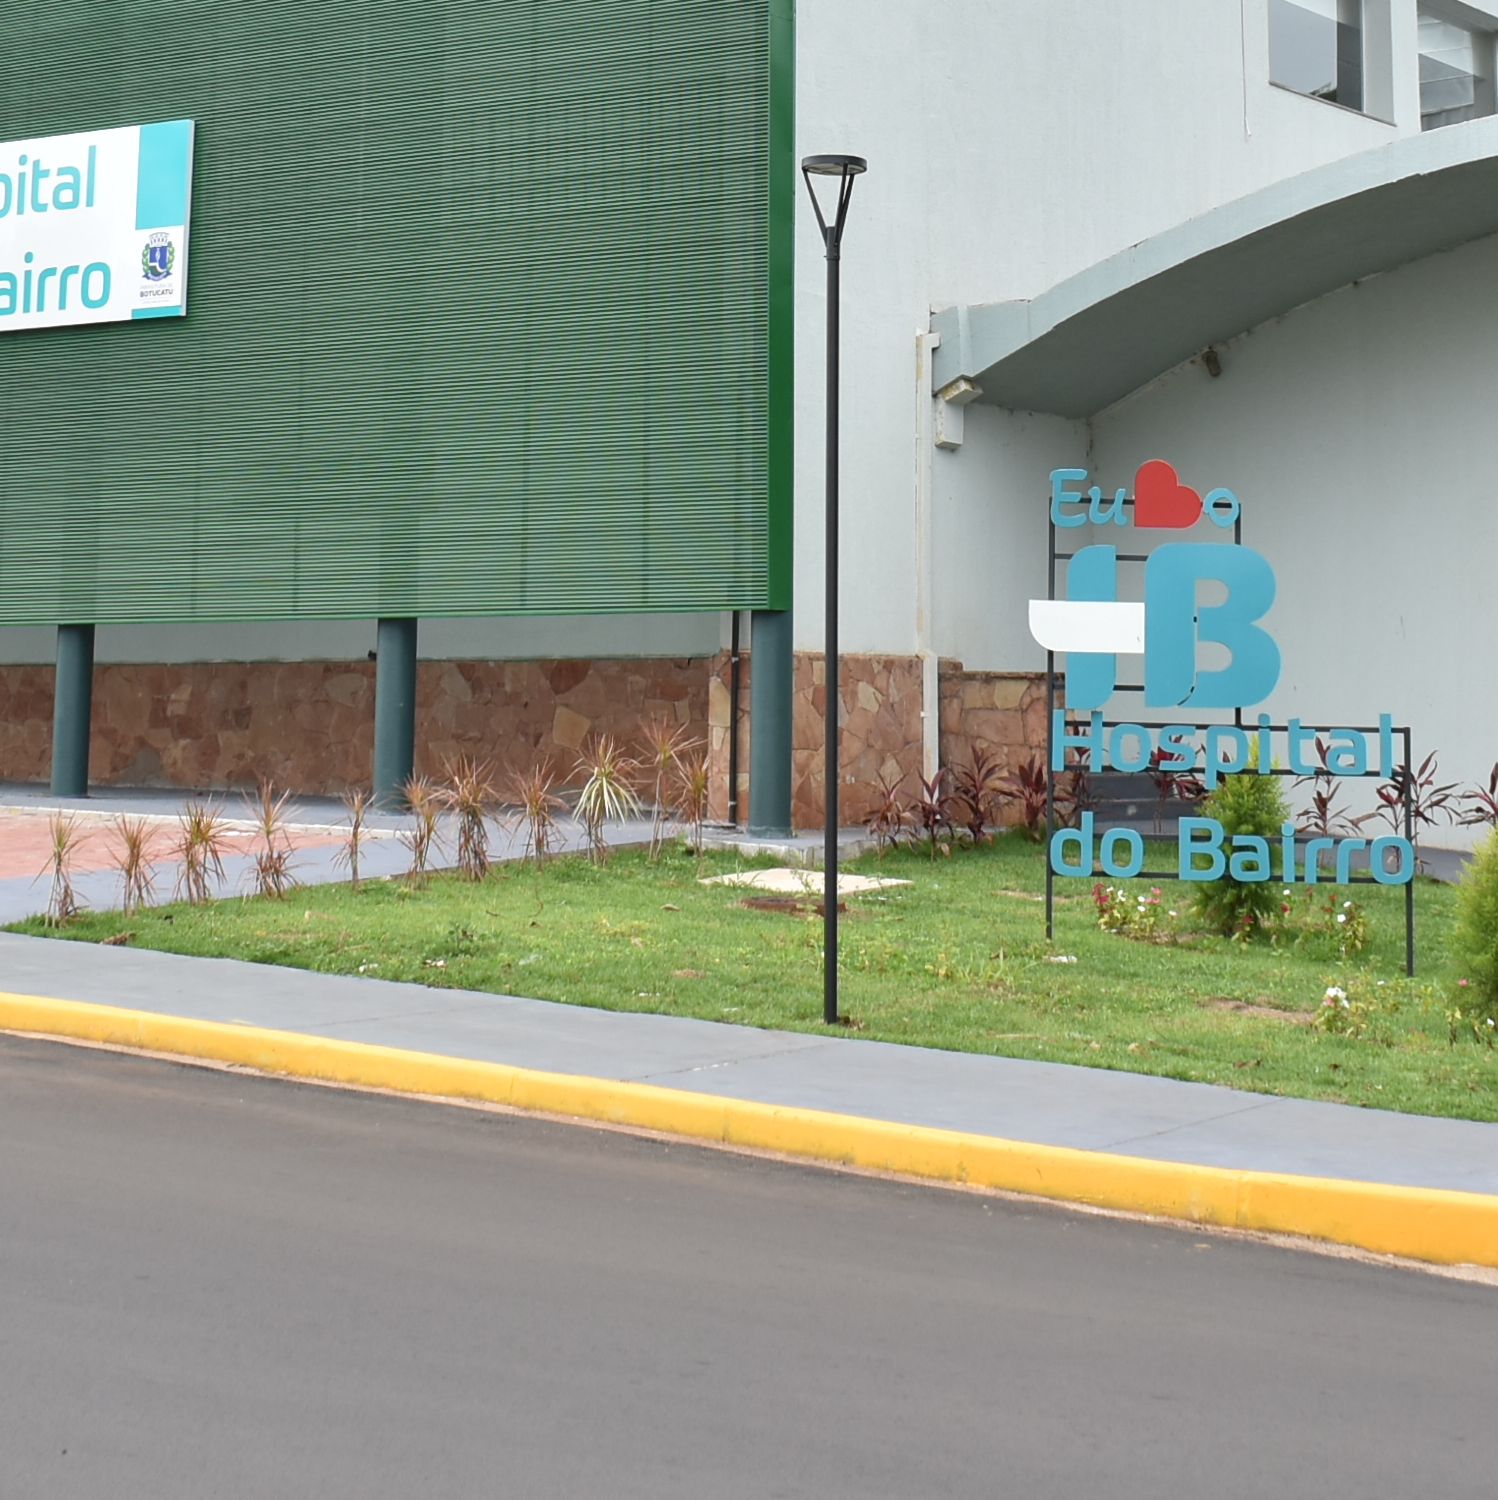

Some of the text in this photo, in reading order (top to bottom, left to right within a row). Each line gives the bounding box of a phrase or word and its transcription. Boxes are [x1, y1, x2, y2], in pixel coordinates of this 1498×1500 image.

[139, 288, 173, 298] BOTUCATU
[1049, 468, 1240, 528] Eu o
[1051, 708, 1394, 791] Hospital
[1049, 810, 1416, 886] do Bairro
